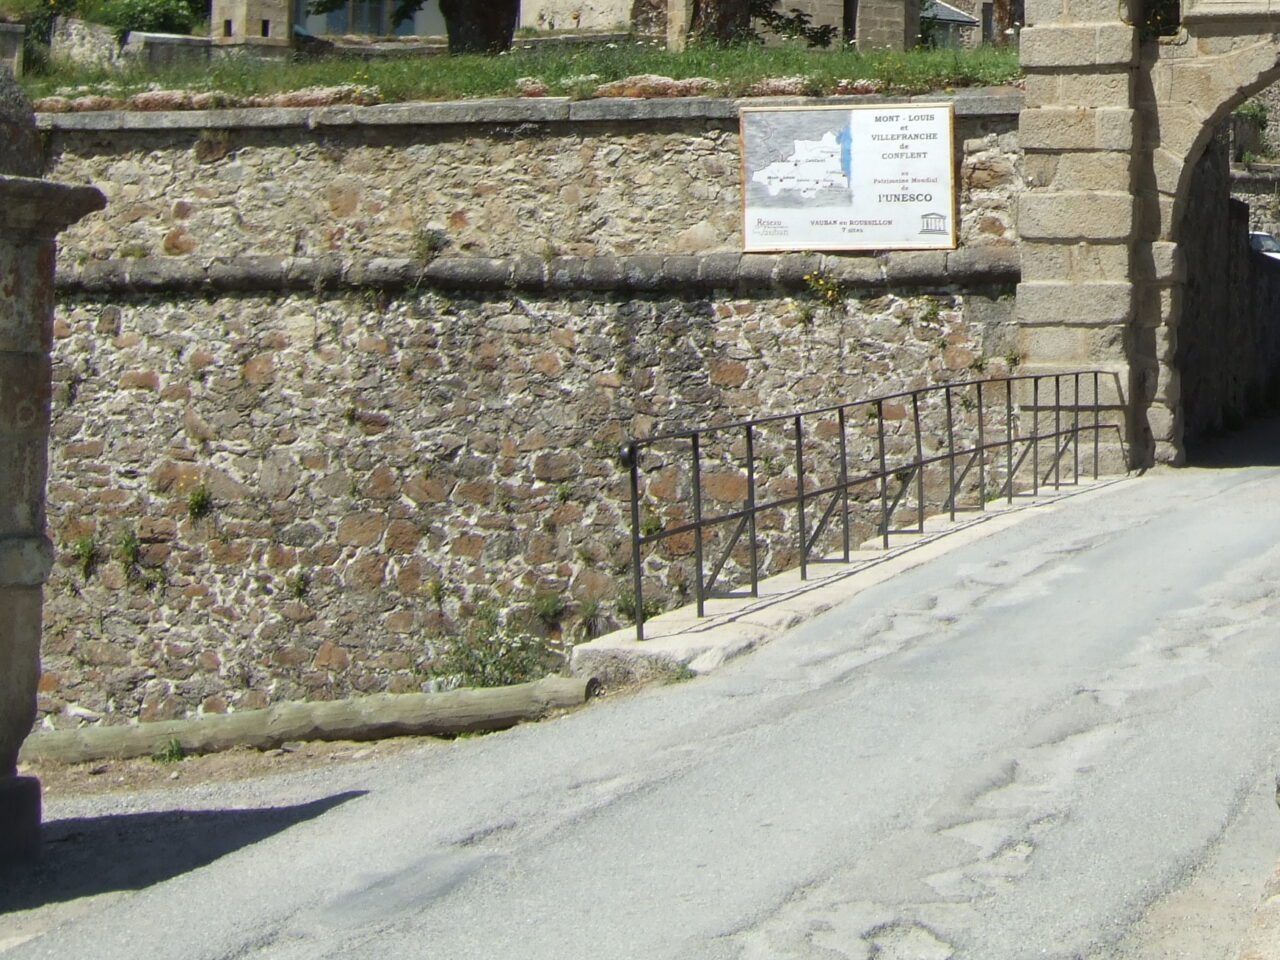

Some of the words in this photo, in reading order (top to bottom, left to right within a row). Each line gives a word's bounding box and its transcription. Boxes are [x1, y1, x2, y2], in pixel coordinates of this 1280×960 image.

[874, 115, 900, 123] MONT
[908, 114, 935, 122] LOUIS
[871, 132, 939, 141] VILLEFRANCHE
[881, 152, 928, 160] CONFLENT
